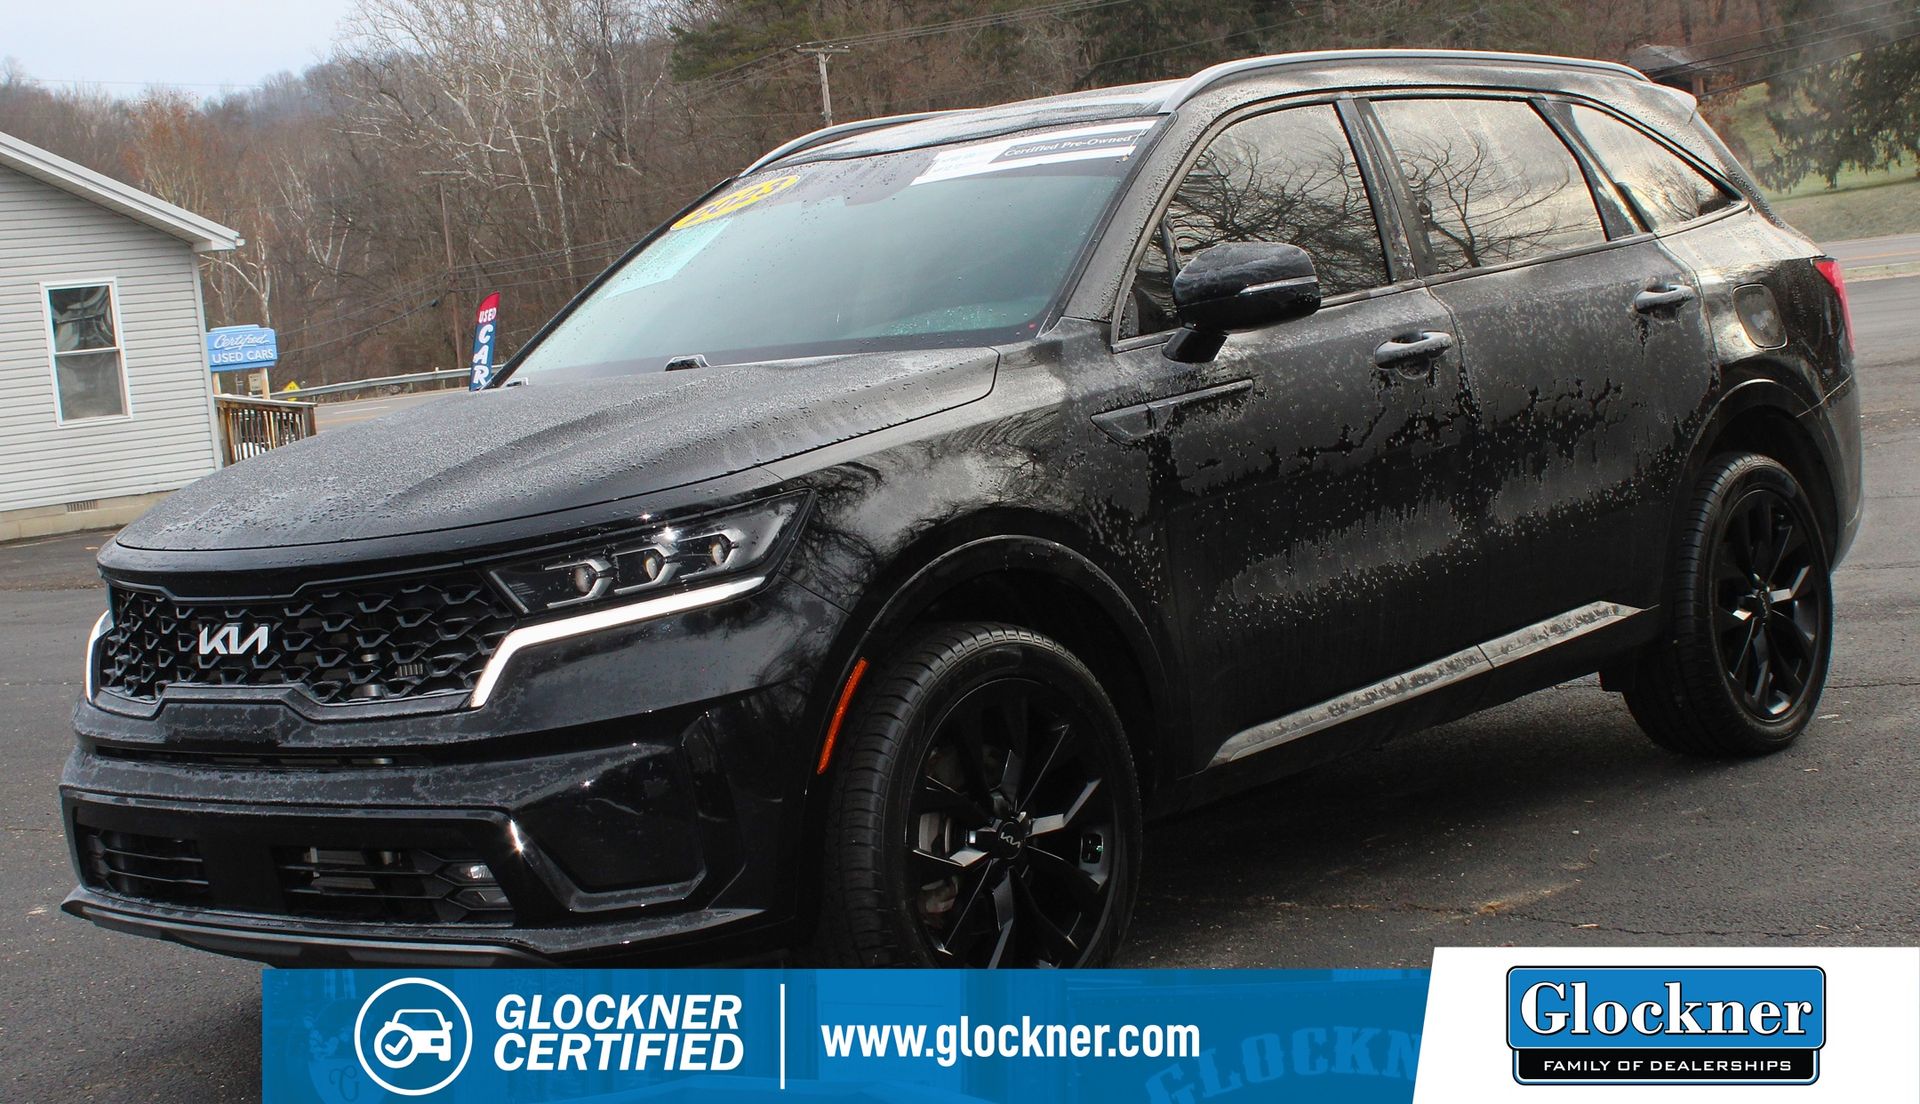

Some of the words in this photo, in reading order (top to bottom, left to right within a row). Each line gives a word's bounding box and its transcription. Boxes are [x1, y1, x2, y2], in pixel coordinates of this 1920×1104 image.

[1004, 143, 1058, 157] Certified
[1060, 135, 1133, 149] Pre-Owned
[479, 307, 497, 323] USED
[214, 334, 270, 351] Certified
[212, 351, 244, 364] USED
[246, 349, 274, 361] CARS
[199, 626, 269, 655] KIA
[1000, 832, 1021, 849] KIA
